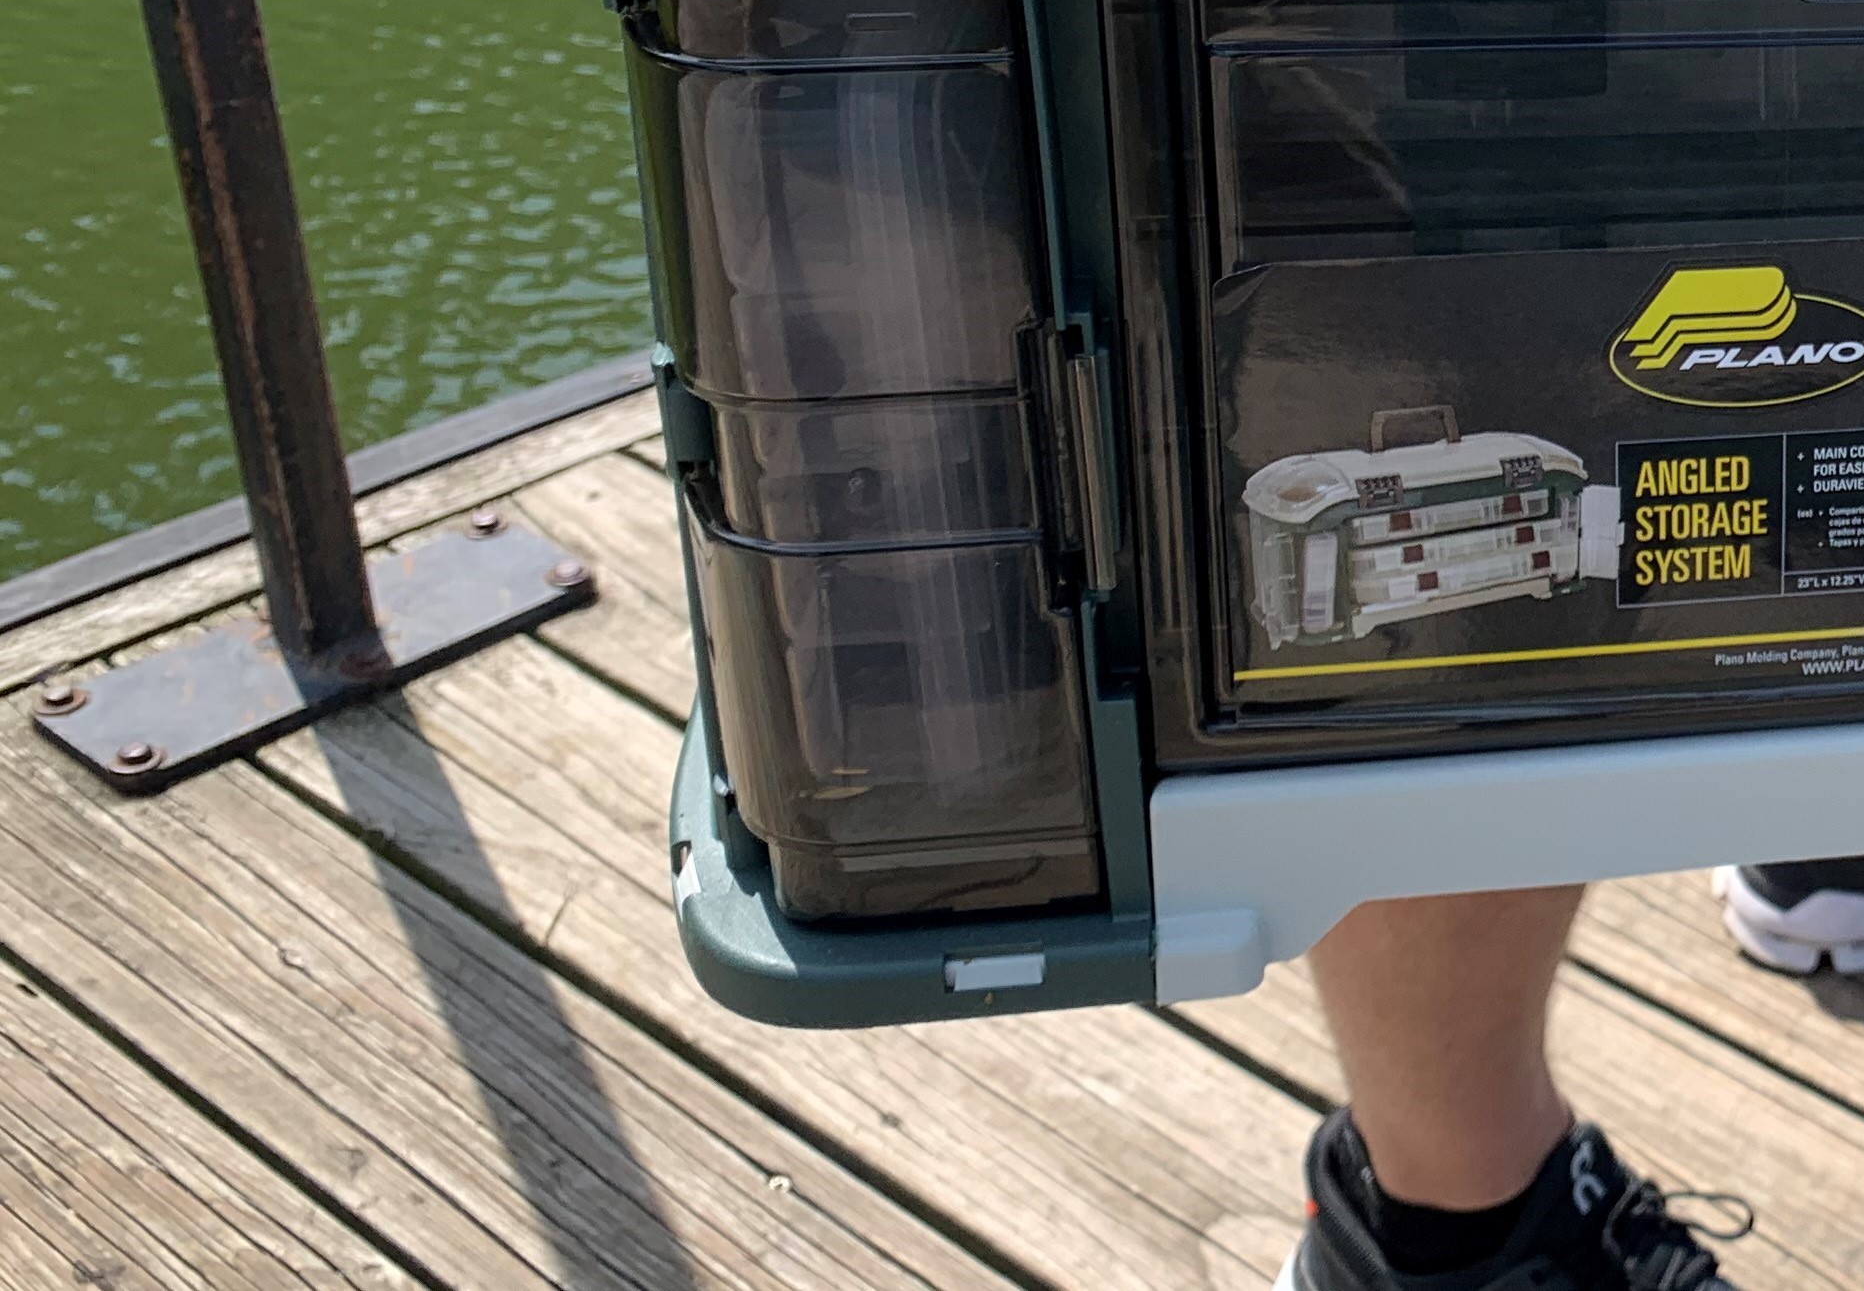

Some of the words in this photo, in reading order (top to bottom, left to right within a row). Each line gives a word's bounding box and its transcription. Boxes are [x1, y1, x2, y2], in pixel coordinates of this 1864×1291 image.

[1813, 447, 1848, 460] MAIN
[1635, 455, 1751, 498] ANGLED
[1813, 463, 1837, 477] FOR
[1635, 499, 1769, 542] STORAGE
[1635, 543, 1751, 586] SYSTEM
[1714, 652, 1745, 666] Plano
[1746, 650, 1789, 665] Molding
